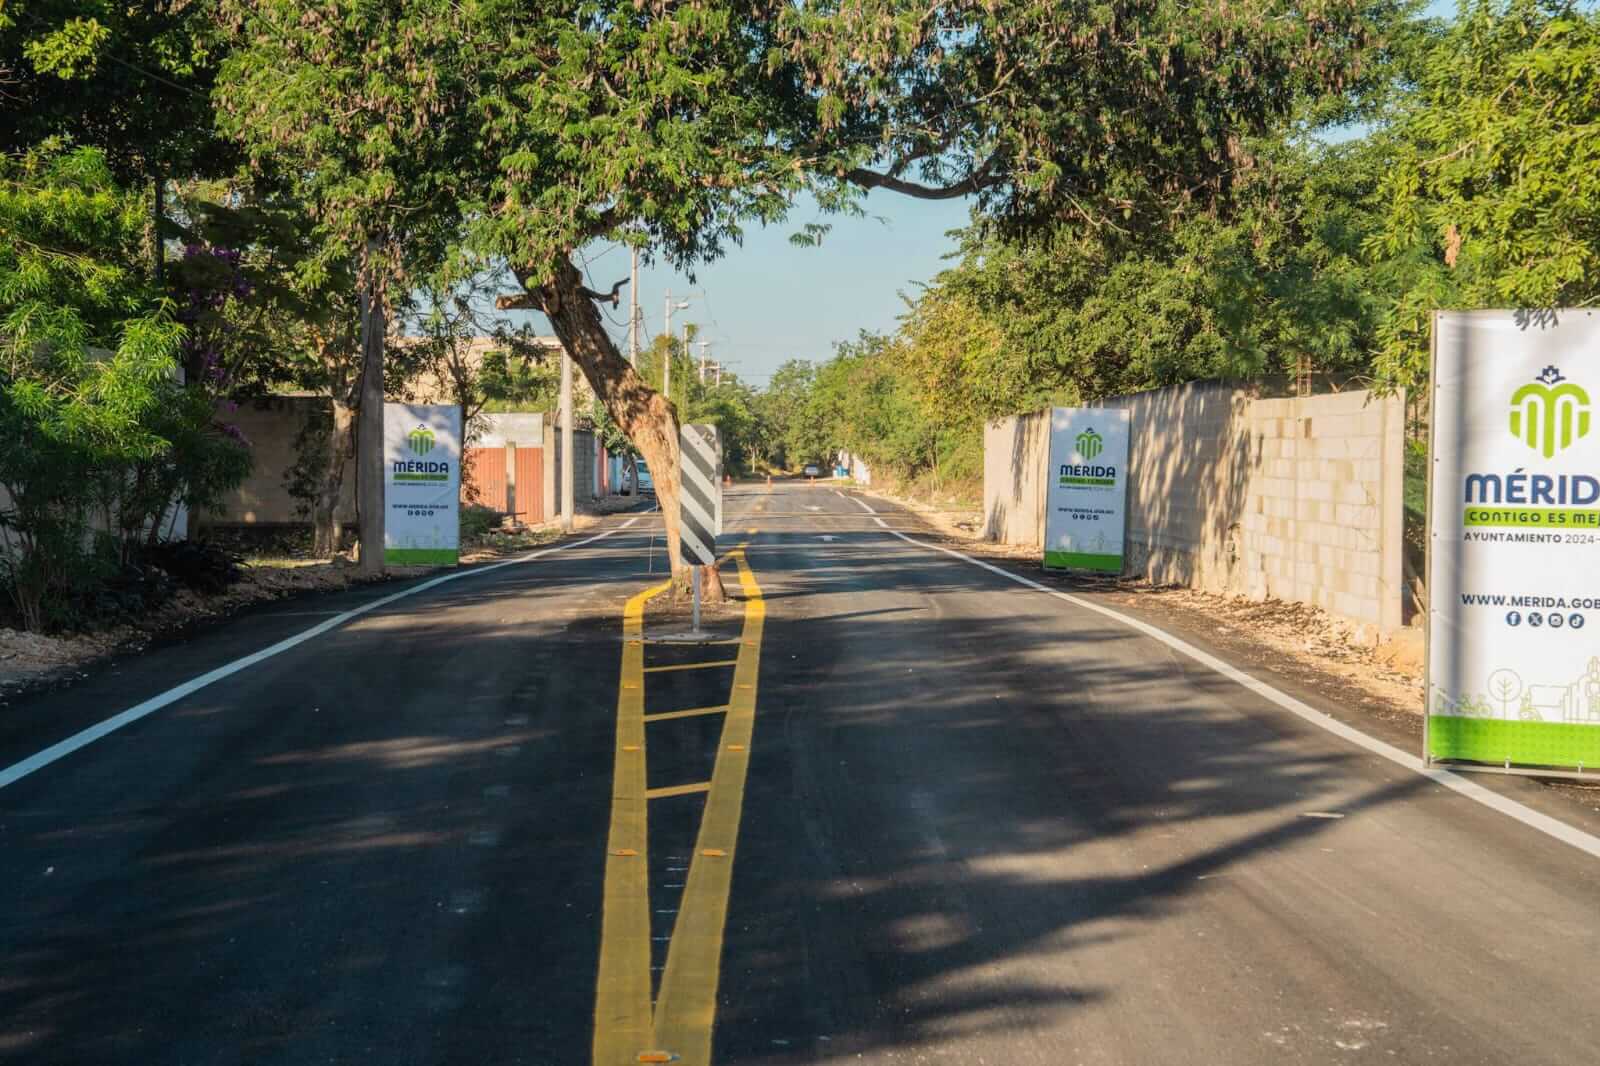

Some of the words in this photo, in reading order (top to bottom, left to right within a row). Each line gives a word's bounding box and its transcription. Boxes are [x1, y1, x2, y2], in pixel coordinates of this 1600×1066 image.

[393, 460, 448, 473] MÉRIDA
[1464, 467, 1600, 505] MÉRID
[1469, 511, 1541, 523] CONTIGO
[1547, 512, 1566, 524] ES
[1572, 512, 1600, 526] ME
[1463, 532, 1562, 544] AYUNTAMIENTO
